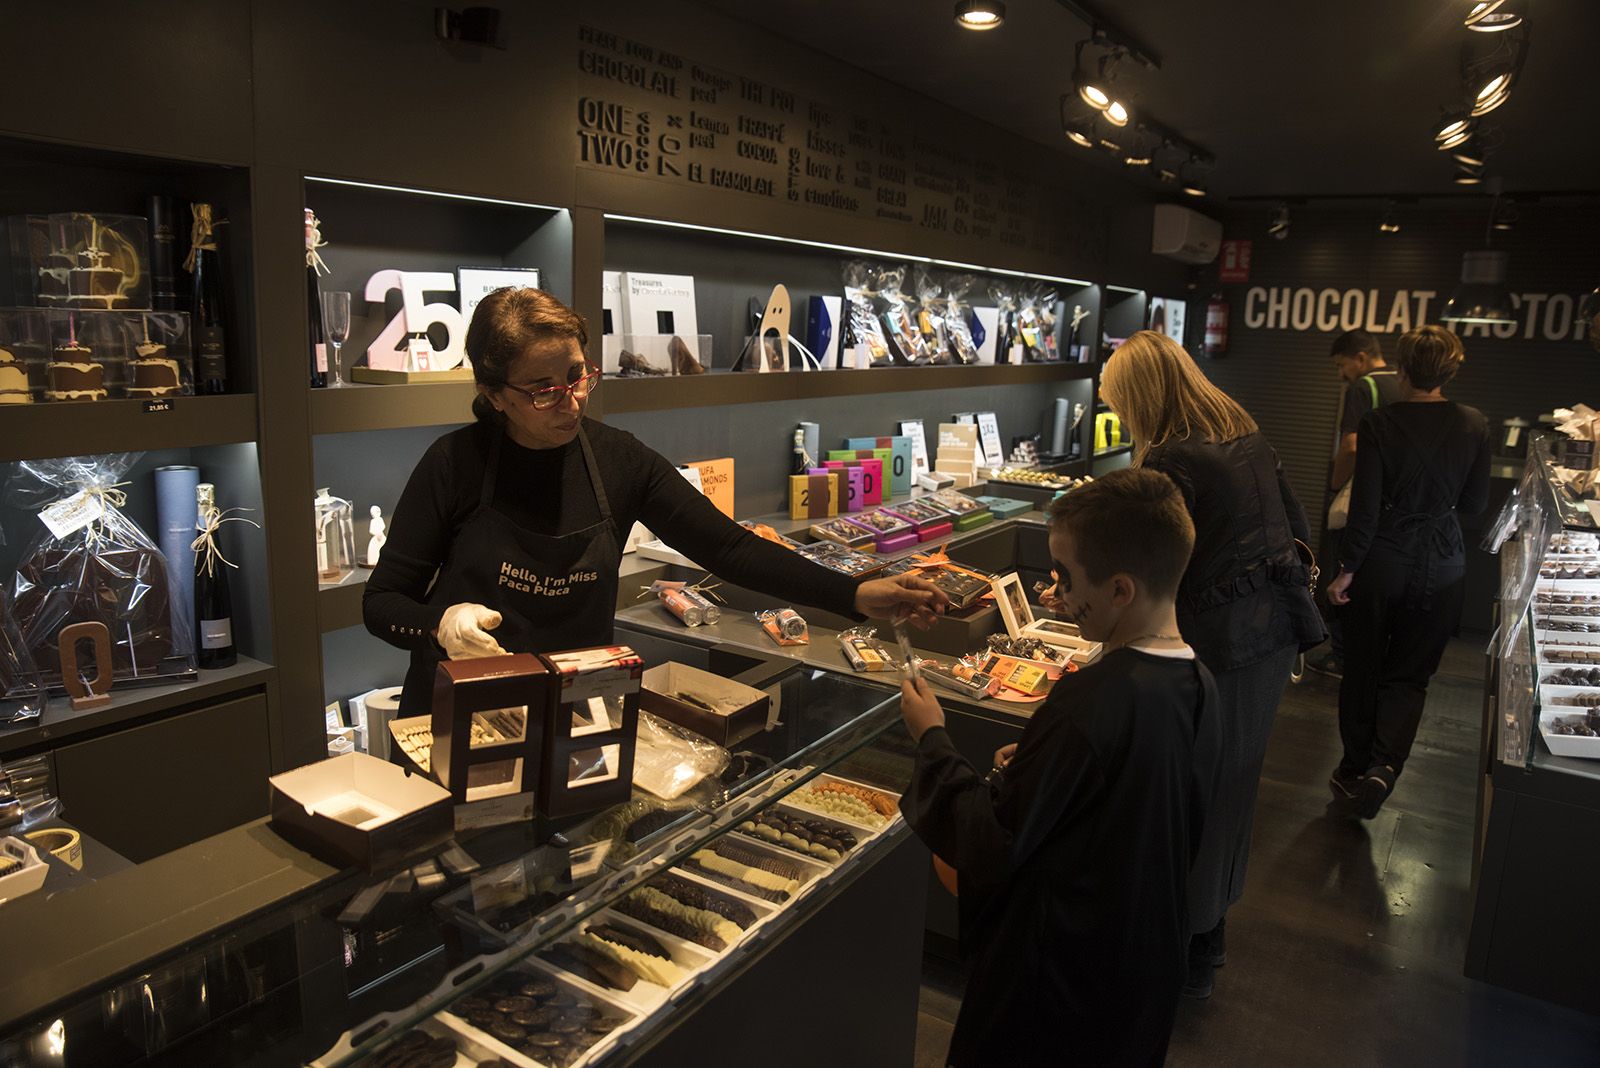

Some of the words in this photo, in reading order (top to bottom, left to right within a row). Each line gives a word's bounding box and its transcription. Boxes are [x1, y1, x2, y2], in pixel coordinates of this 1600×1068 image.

[578, 48, 681, 100] CHOCOLATE
[739, 76, 765, 105] THE
[770, 87, 797, 115] POT
[577, 96, 633, 137] ONE
[577, 130, 633, 169] TWO
[737, 139, 779, 165] COCOA
[807, 129, 848, 158] kisses
[689, 162, 707, 185] EL
[806, 156, 832, 181] love
[805, 187, 860, 212] emotions
[631, 276, 663, 287] Treasures
[632, 287, 640, 296] by
[1244, 286, 1436, 334] CHOCOLAT
[700, 465, 715, 476] UFA
[700, 473, 728, 487] MONDS
[498, 575, 531, 593] Paca
[533, 584, 570, 597] Placa
[500, 561, 541, 586] Hello,
[544, 576, 566, 587] I'm
[568, 571, 598, 584] Miss
